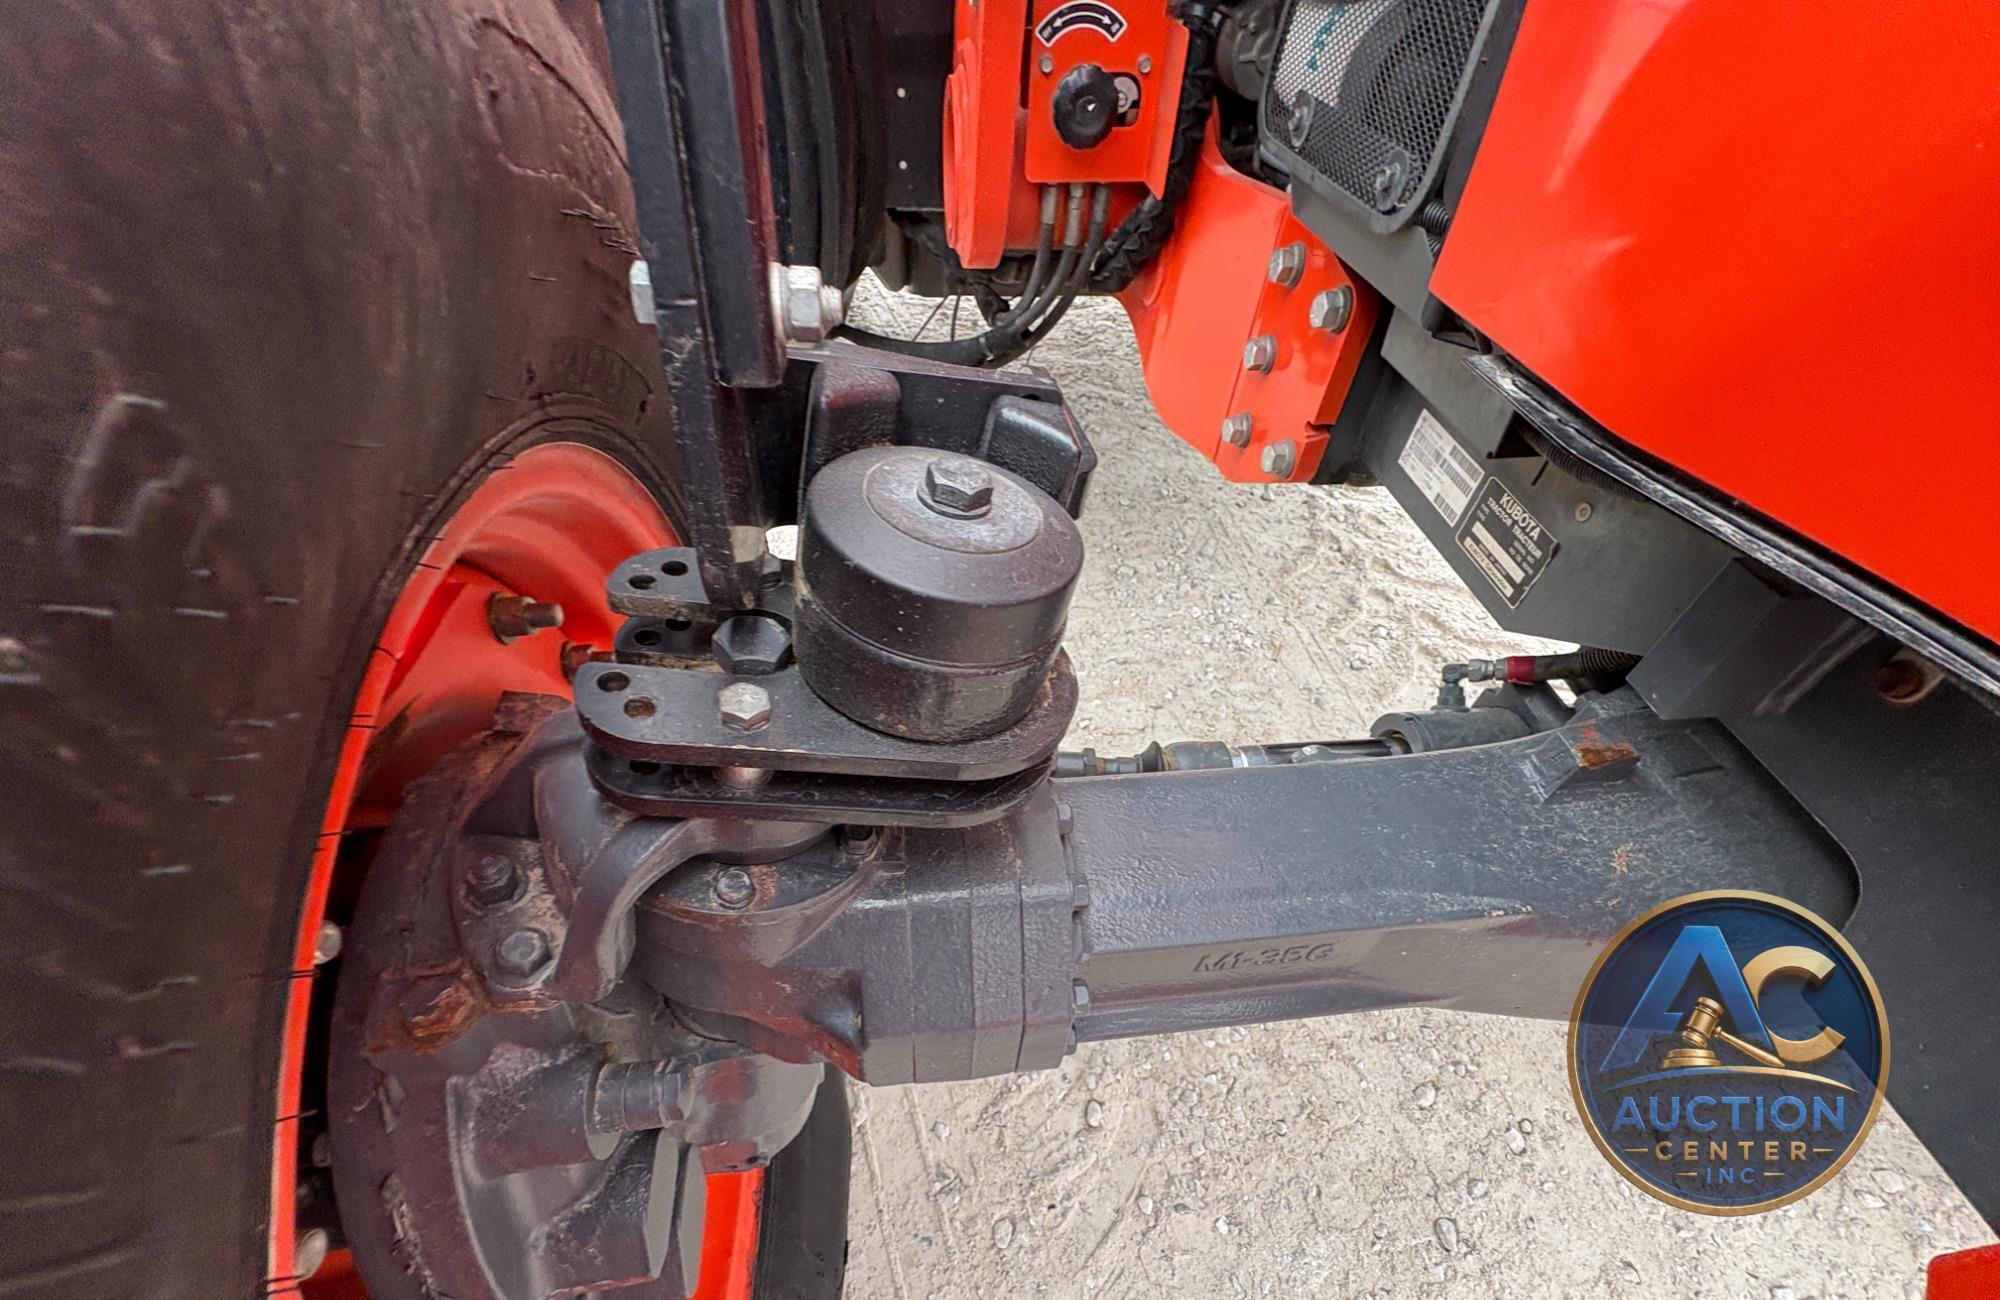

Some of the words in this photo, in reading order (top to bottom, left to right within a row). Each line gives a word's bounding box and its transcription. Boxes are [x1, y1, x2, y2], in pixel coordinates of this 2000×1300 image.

[1487, 497, 1513, 527] TRACTOR
[1512, 525, 1543, 559] TRACTEUR
[1499, 492, 1541, 541] KUBOTA
